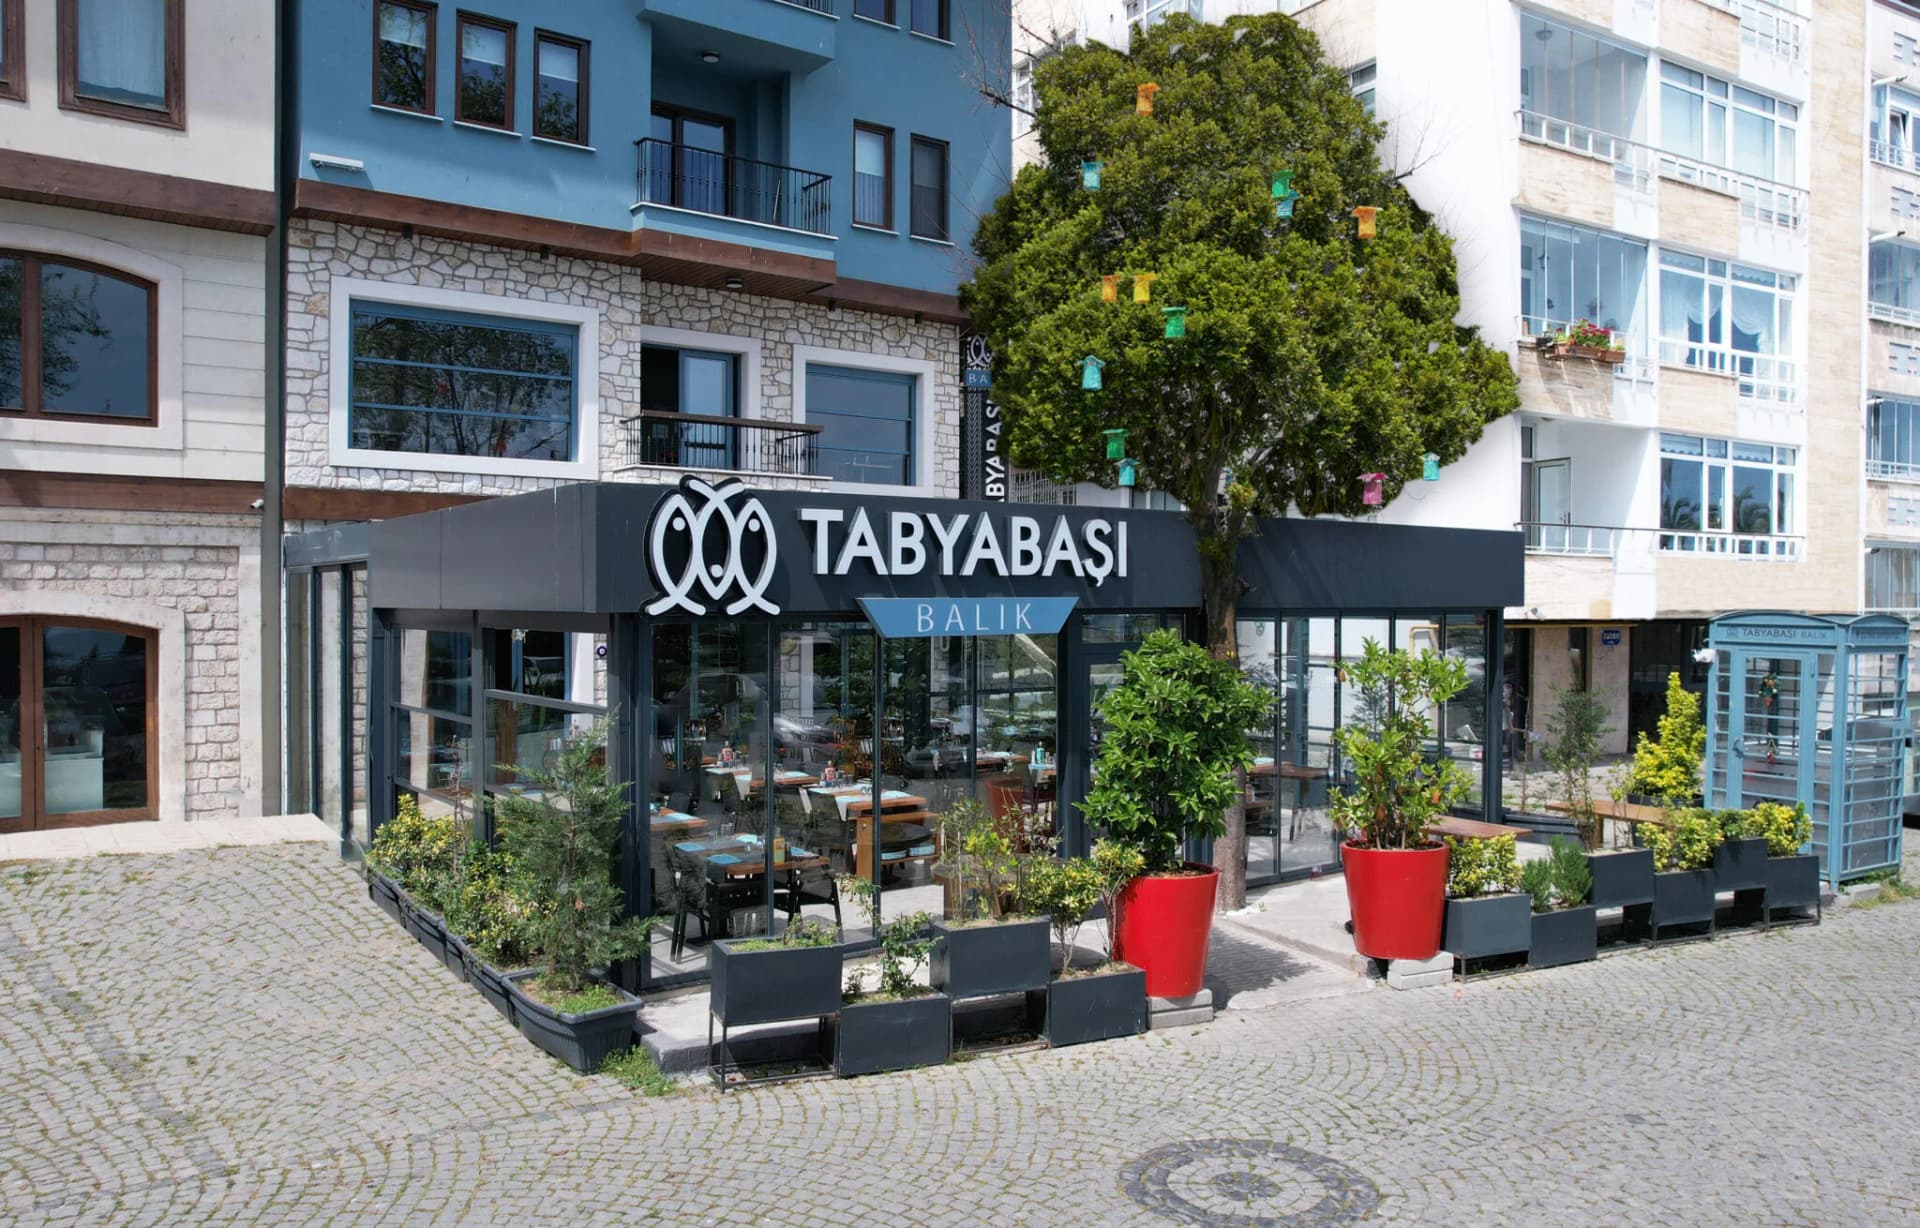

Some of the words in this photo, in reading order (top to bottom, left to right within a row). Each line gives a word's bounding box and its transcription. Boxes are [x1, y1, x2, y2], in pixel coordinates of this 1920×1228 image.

[800, 505, 1127, 587] TABYABAŞI
[917, 602, 1032, 633] BALIK
[1742, 628, 1797, 639] TABYABAŞI
